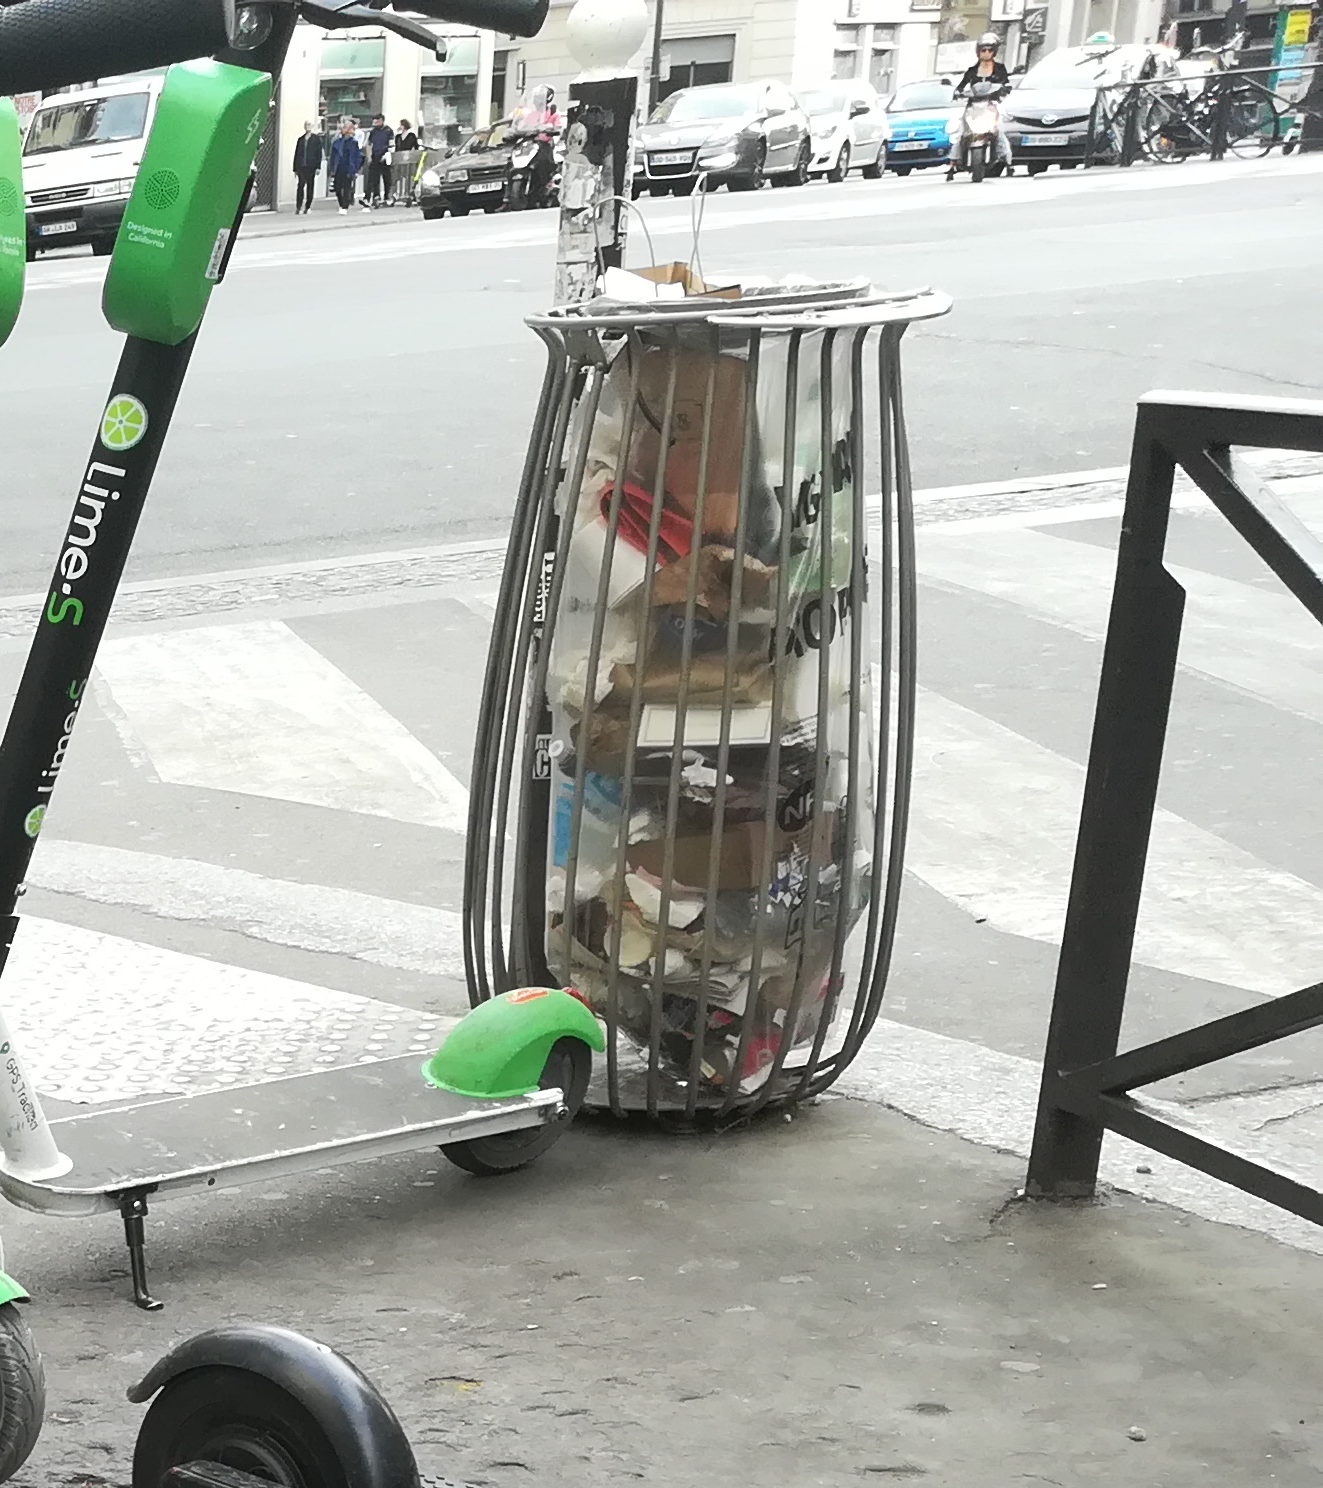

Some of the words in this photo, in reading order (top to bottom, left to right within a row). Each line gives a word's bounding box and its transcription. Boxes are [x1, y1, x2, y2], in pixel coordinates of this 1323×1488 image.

[127, 220, 163, 236] Designed
[164, 228, 173, 239] in
[128, 232, 165, 249] California
